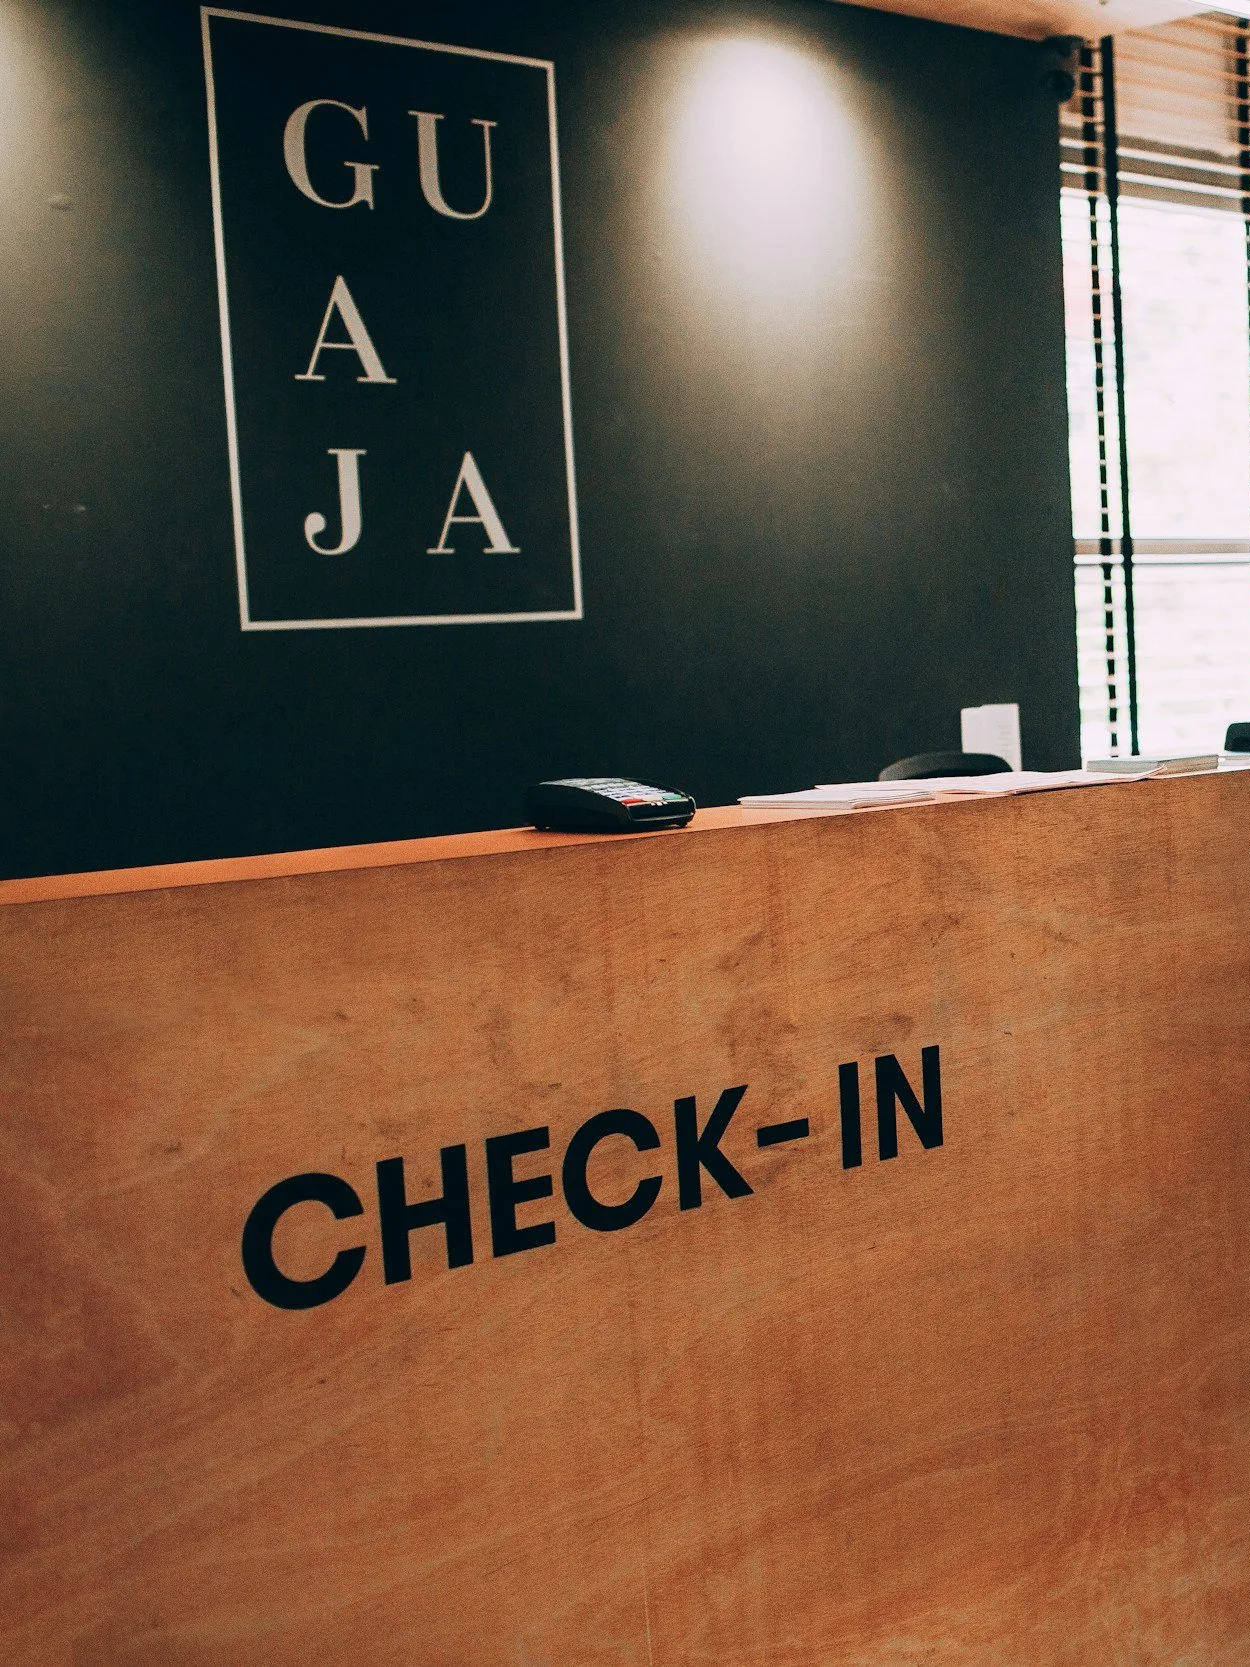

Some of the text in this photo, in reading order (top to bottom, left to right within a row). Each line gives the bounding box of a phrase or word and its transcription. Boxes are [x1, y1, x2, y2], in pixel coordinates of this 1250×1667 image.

[283, 98, 498, 220] GU
[295, 275, 397, 384] A
[304, 449, 521, 555] JA
[241, 1044, 944, 1311] CHECK-IN
